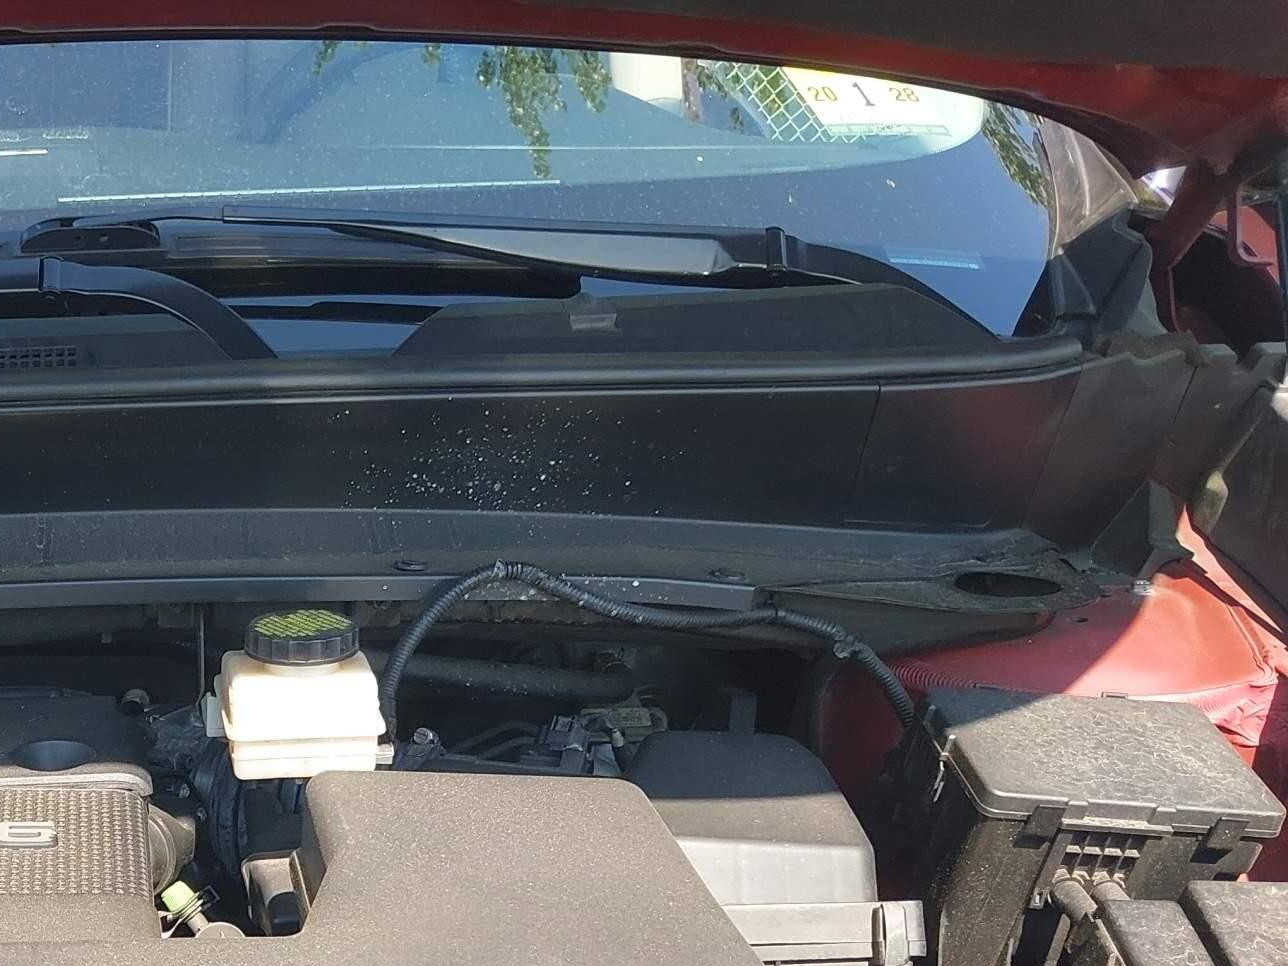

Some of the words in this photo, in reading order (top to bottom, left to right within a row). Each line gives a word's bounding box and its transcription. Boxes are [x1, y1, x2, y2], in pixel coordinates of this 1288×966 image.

[808, 86, 838, 102] 20
[852, 82, 876, 107] 1
[889, 87, 920, 102] 28
